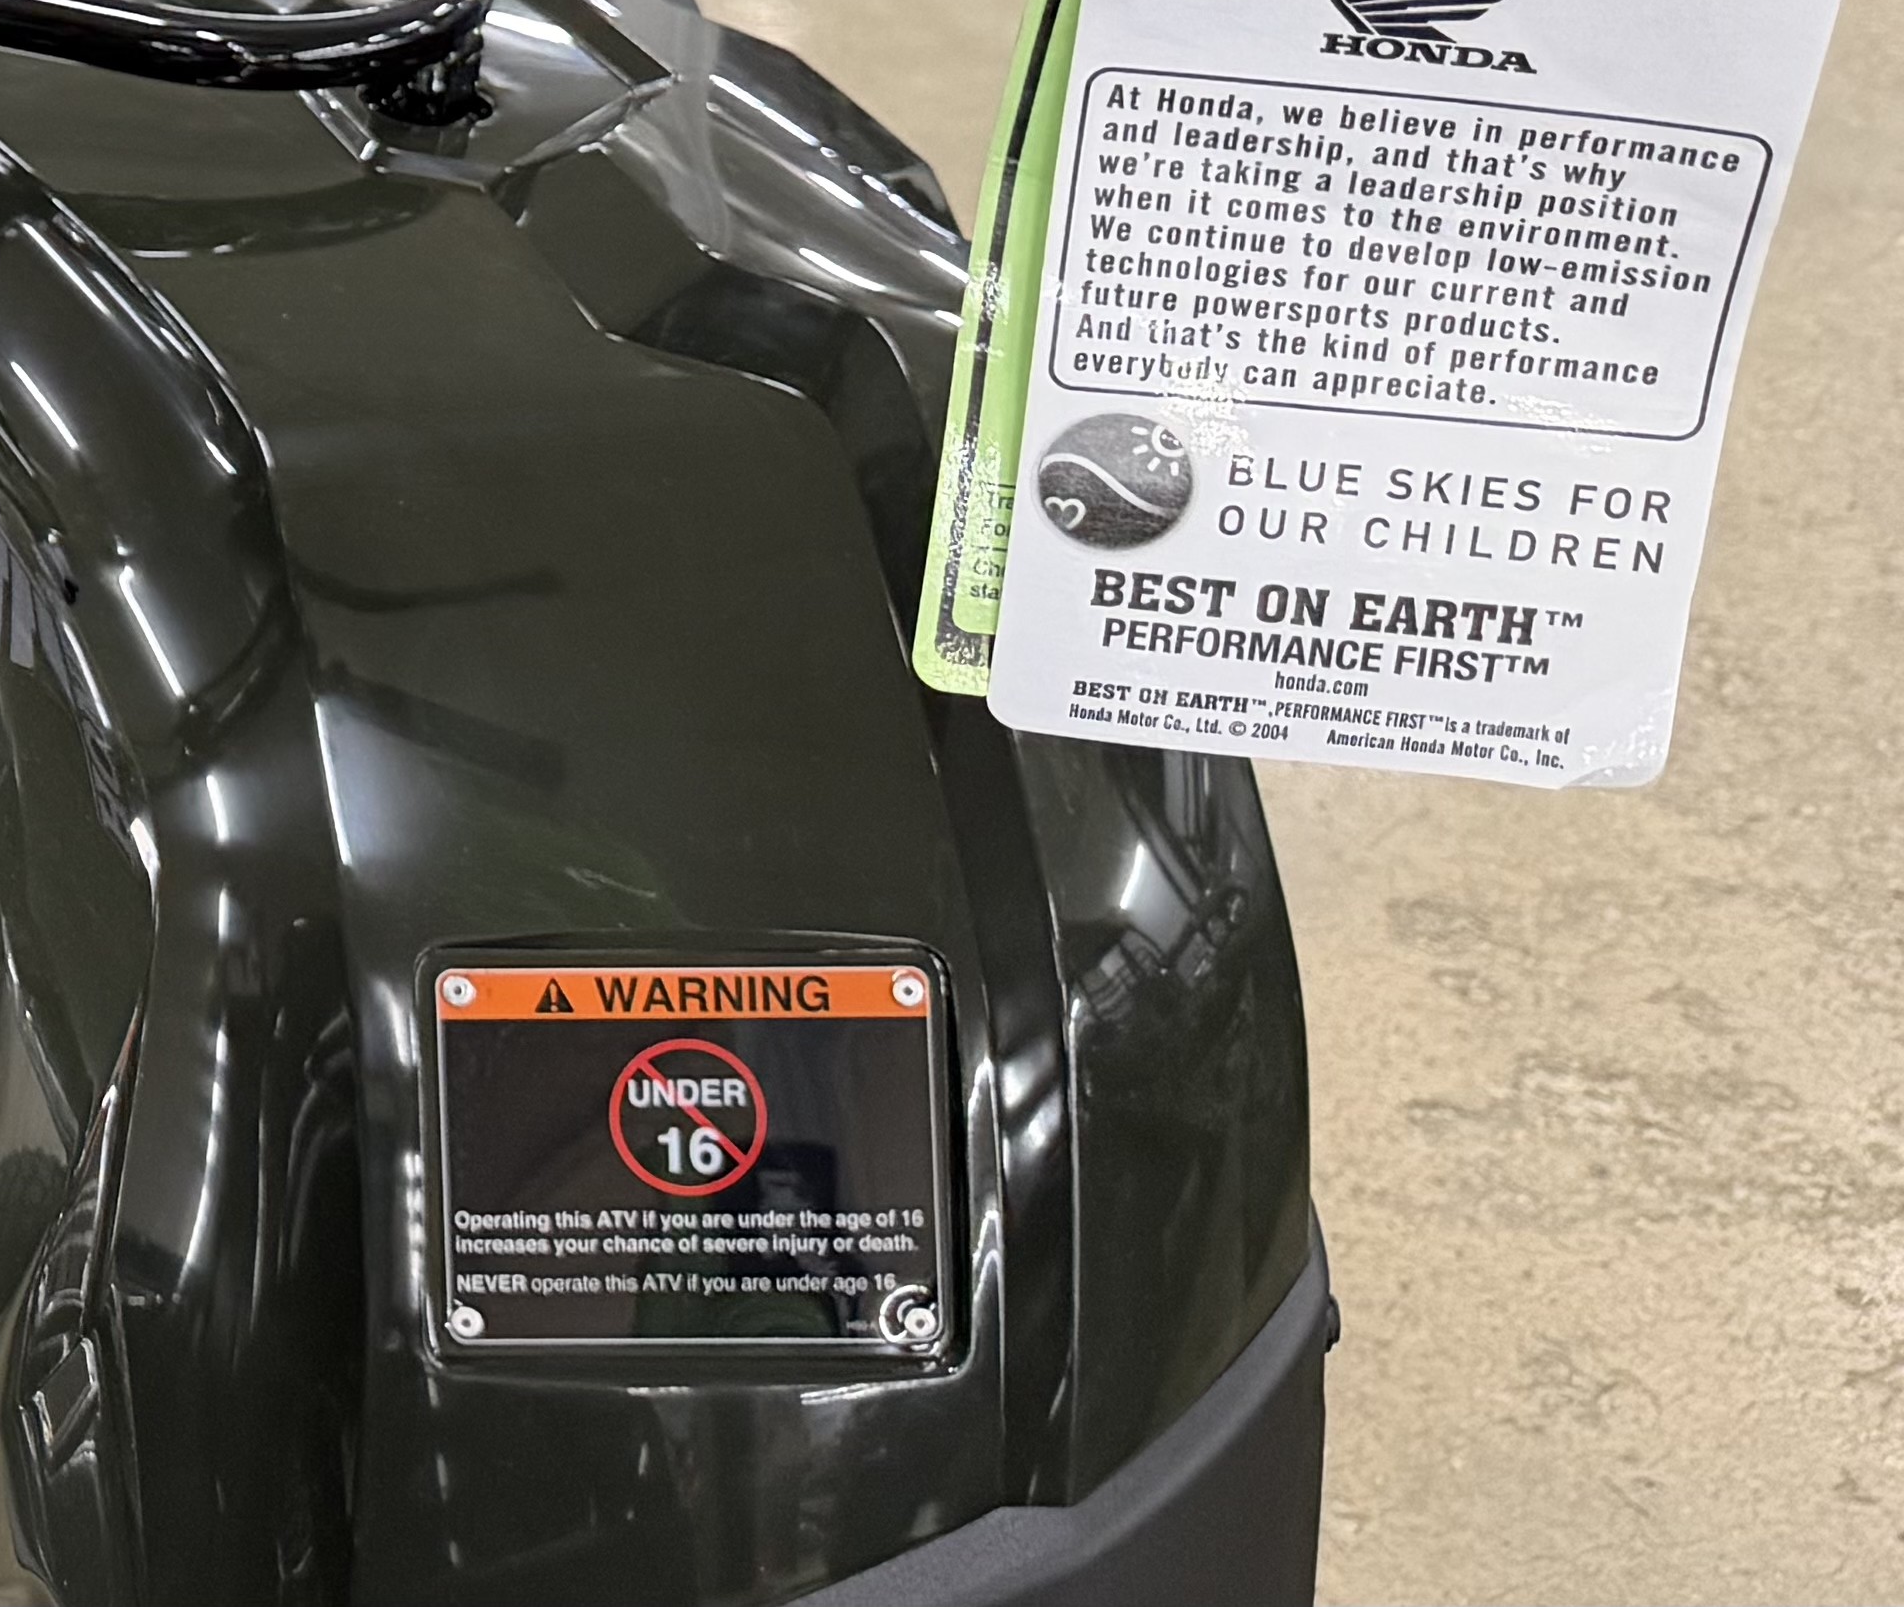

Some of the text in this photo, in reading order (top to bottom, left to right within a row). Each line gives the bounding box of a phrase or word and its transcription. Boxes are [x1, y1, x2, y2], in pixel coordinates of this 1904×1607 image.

[1320, 33, 1537, 74] HONDA
[1103, 119, 1626, 192] and leadership, and that's why
[1107, 84, 1740, 172] At Honda, we believe in performance
[1099, 152, 1677, 227] we're taking a leadership position
[1095, 183, 1678, 259] when it comes to the environment.
[1091, 214, 1711, 293] We continue to develop low-emission
[1086, 248, 1629, 317] technologies for our current and
[1081, 280, 1559, 344] future powersports products.
[1076, 313, 1658, 385] And that's the kind of performance
[1244, 365, 1296, 388] can
[1313, 371, 1496, 405] appreciate.
[1229, 454, 1670, 524] BLUE SKIES FOR
[1219, 505, 1663, 574] OUR CHILDREN
[1090, 569, 1236, 618] BEST
[1257, 584, 1330, 627] ON
[1102, 618, 1384, 673] PERFORMANCE
[1274, 671, 1369, 697] honda.com
[1069, 703, 1112, 722] Honda
[1117, 709, 1159, 728] Motor
[1163, 714, 1190, 733] Co.,
[1196, 717, 1222, 734] Ltd.
[1251, 723, 1288, 740] 2004
[1327, 729, 1564, 769] American Honda Motor Co., Inc.
[595, 975, 830, 1012] WARNING
[627, 1079, 747, 1108] UNDER
[657, 1127, 725, 1175] 16
[454, 1209, 924, 1233] Operating this ATV if you are under the age of 16
[456, 1234, 918, 1257] increases your chance of severe injury or death.
[457, 1274, 528, 1293] NEVER
[531, 1276, 601, 1295] operate
[605, 1274, 638, 1292] this
[643, 1273, 682, 1291] ATV
[687, 1274, 698, 1291] if
[702, 1277, 736, 1295] you
[741, 1277, 771, 1291] are
[776, 1274, 828, 1291] under
[833, 1277, 868, 1295] age
